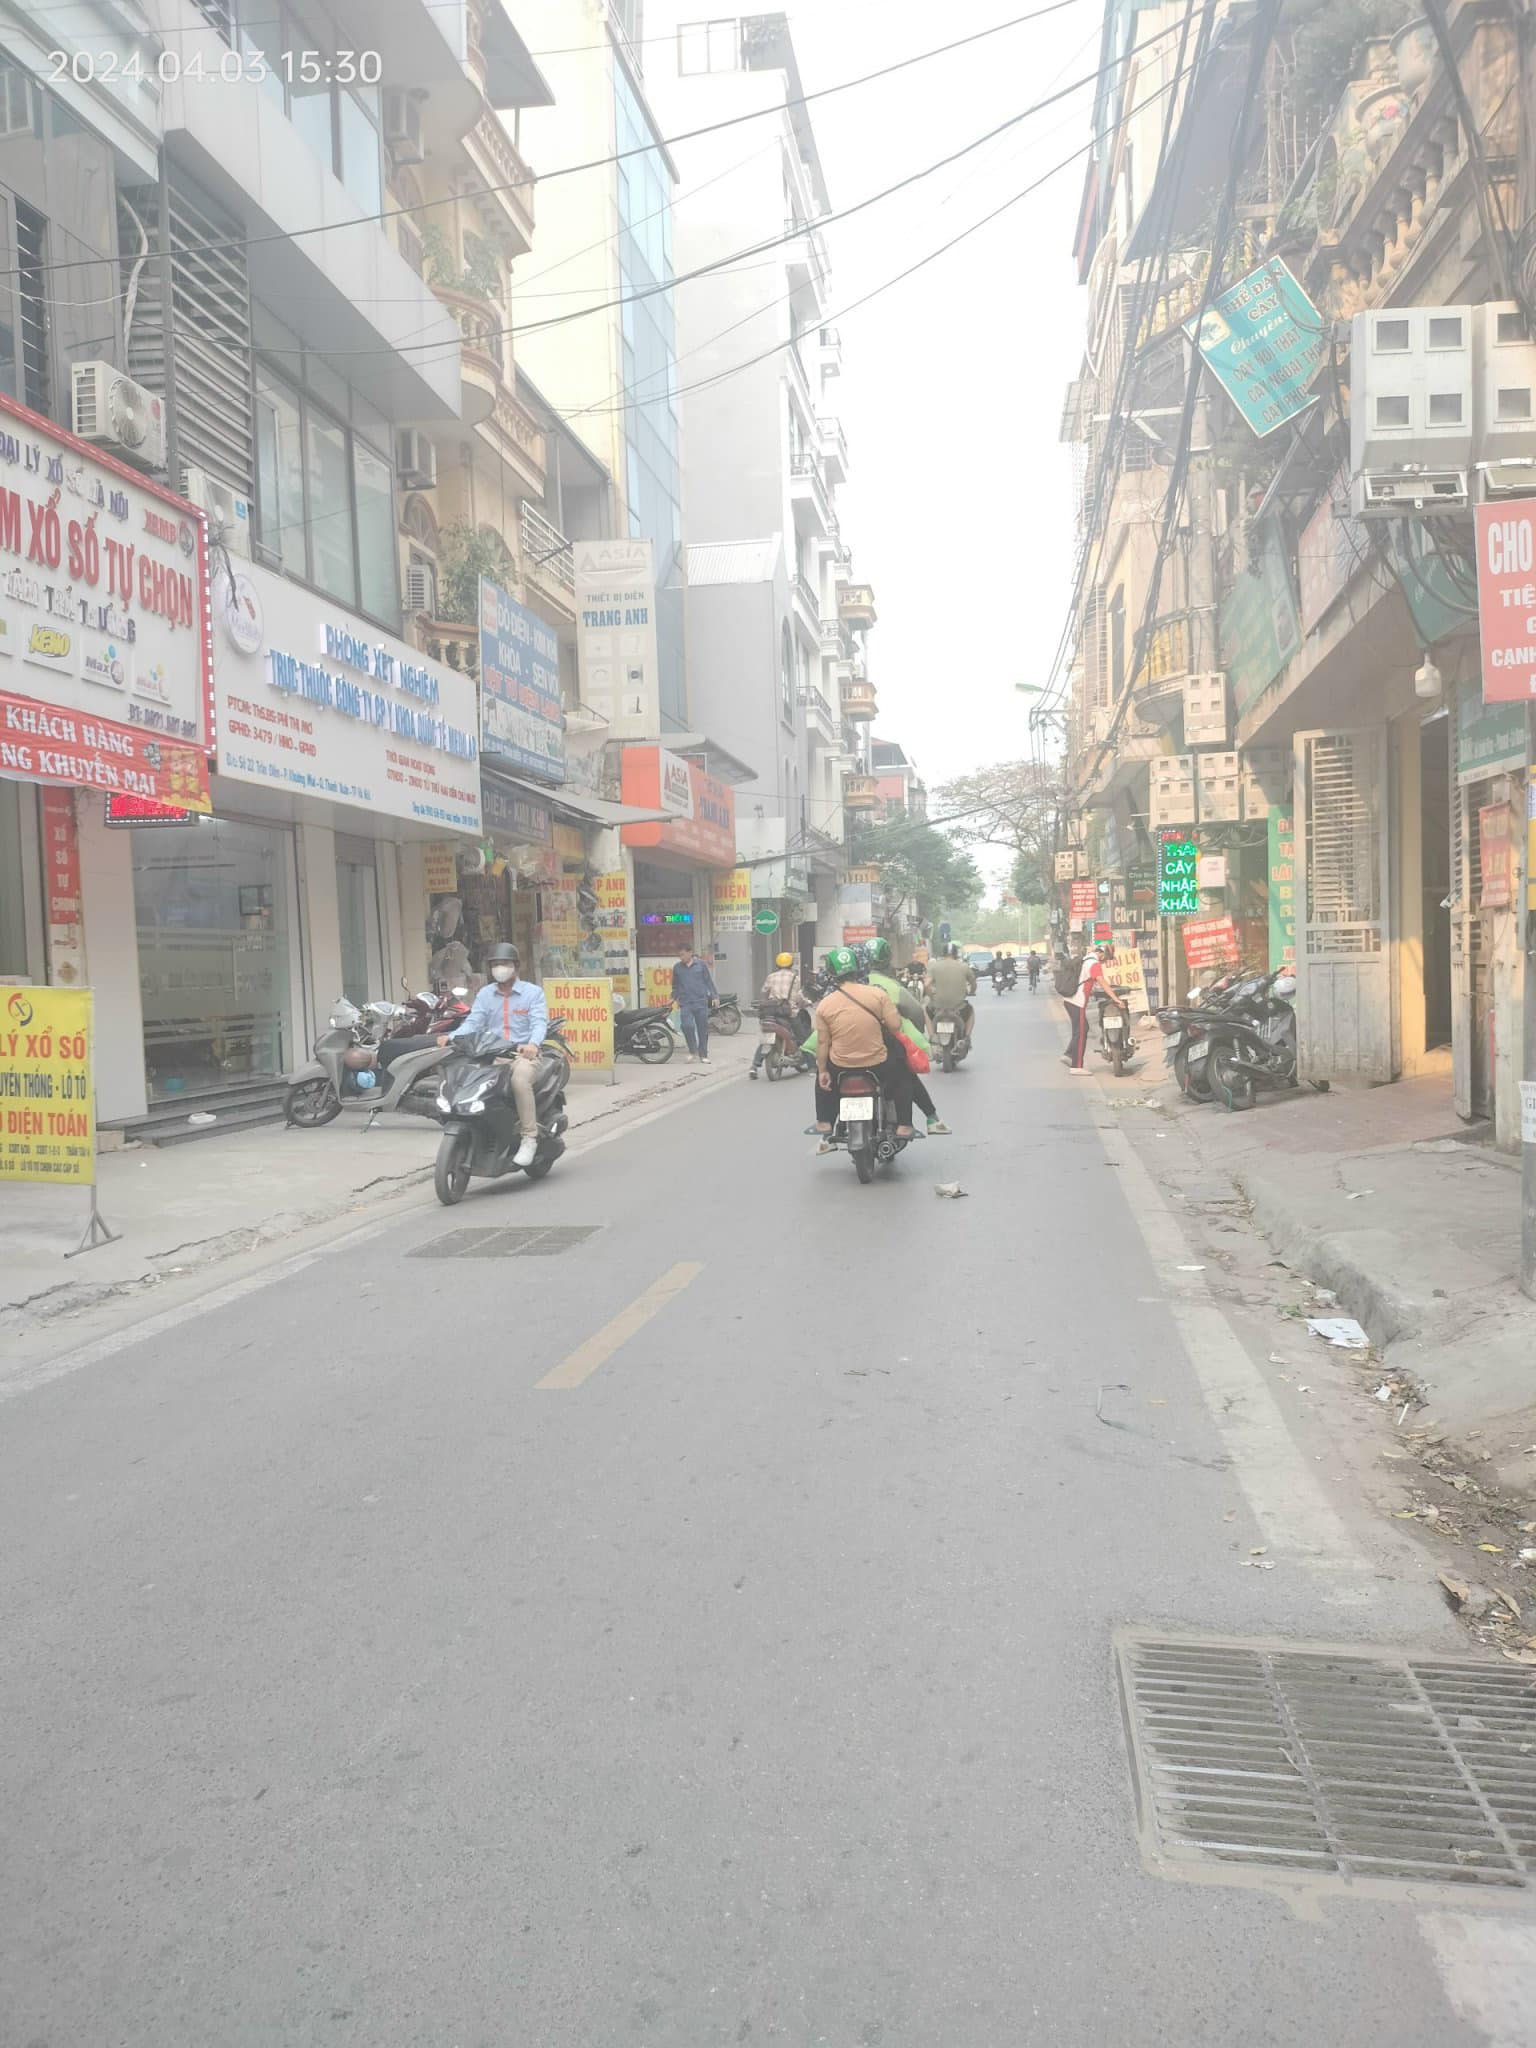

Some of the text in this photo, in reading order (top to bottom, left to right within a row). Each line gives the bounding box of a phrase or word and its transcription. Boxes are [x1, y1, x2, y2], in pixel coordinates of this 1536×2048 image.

[26, 487, 61, 569] XỔ
[68, 512, 100, 587] SỐ
[104, 536, 135, 612] TỰ
[139, 553, 193, 632] CHỌN
[1488, 519, 1532, 575] CHO
[582, 608, 649, 628] TRANG ANH
[6, 704, 77, 743] KHÁCH
[82, 721, 134, 757] HÀNG
[38, 750, 120, 787] KHUYẾN
[123, 769, 157, 799] MẠI
[1165, 859, 1194, 875] CÂY
[1161, 892, 1199, 911] KHẨU
[574, 985, 601, 1003] ĐIỆN
[578, 1004, 608, 1022] NƯỚC
[26, 1025, 53, 1059] XỔ
[59, 1027, 86, 1060] SỐ
[581, 1026, 601, 1044] KHÍ
[583, 1050, 606, 1065] HỢP
[24, 1064, 53, 1099] THỐNG
[8, 1107, 88, 1140] ĐIỆN TOÁN
